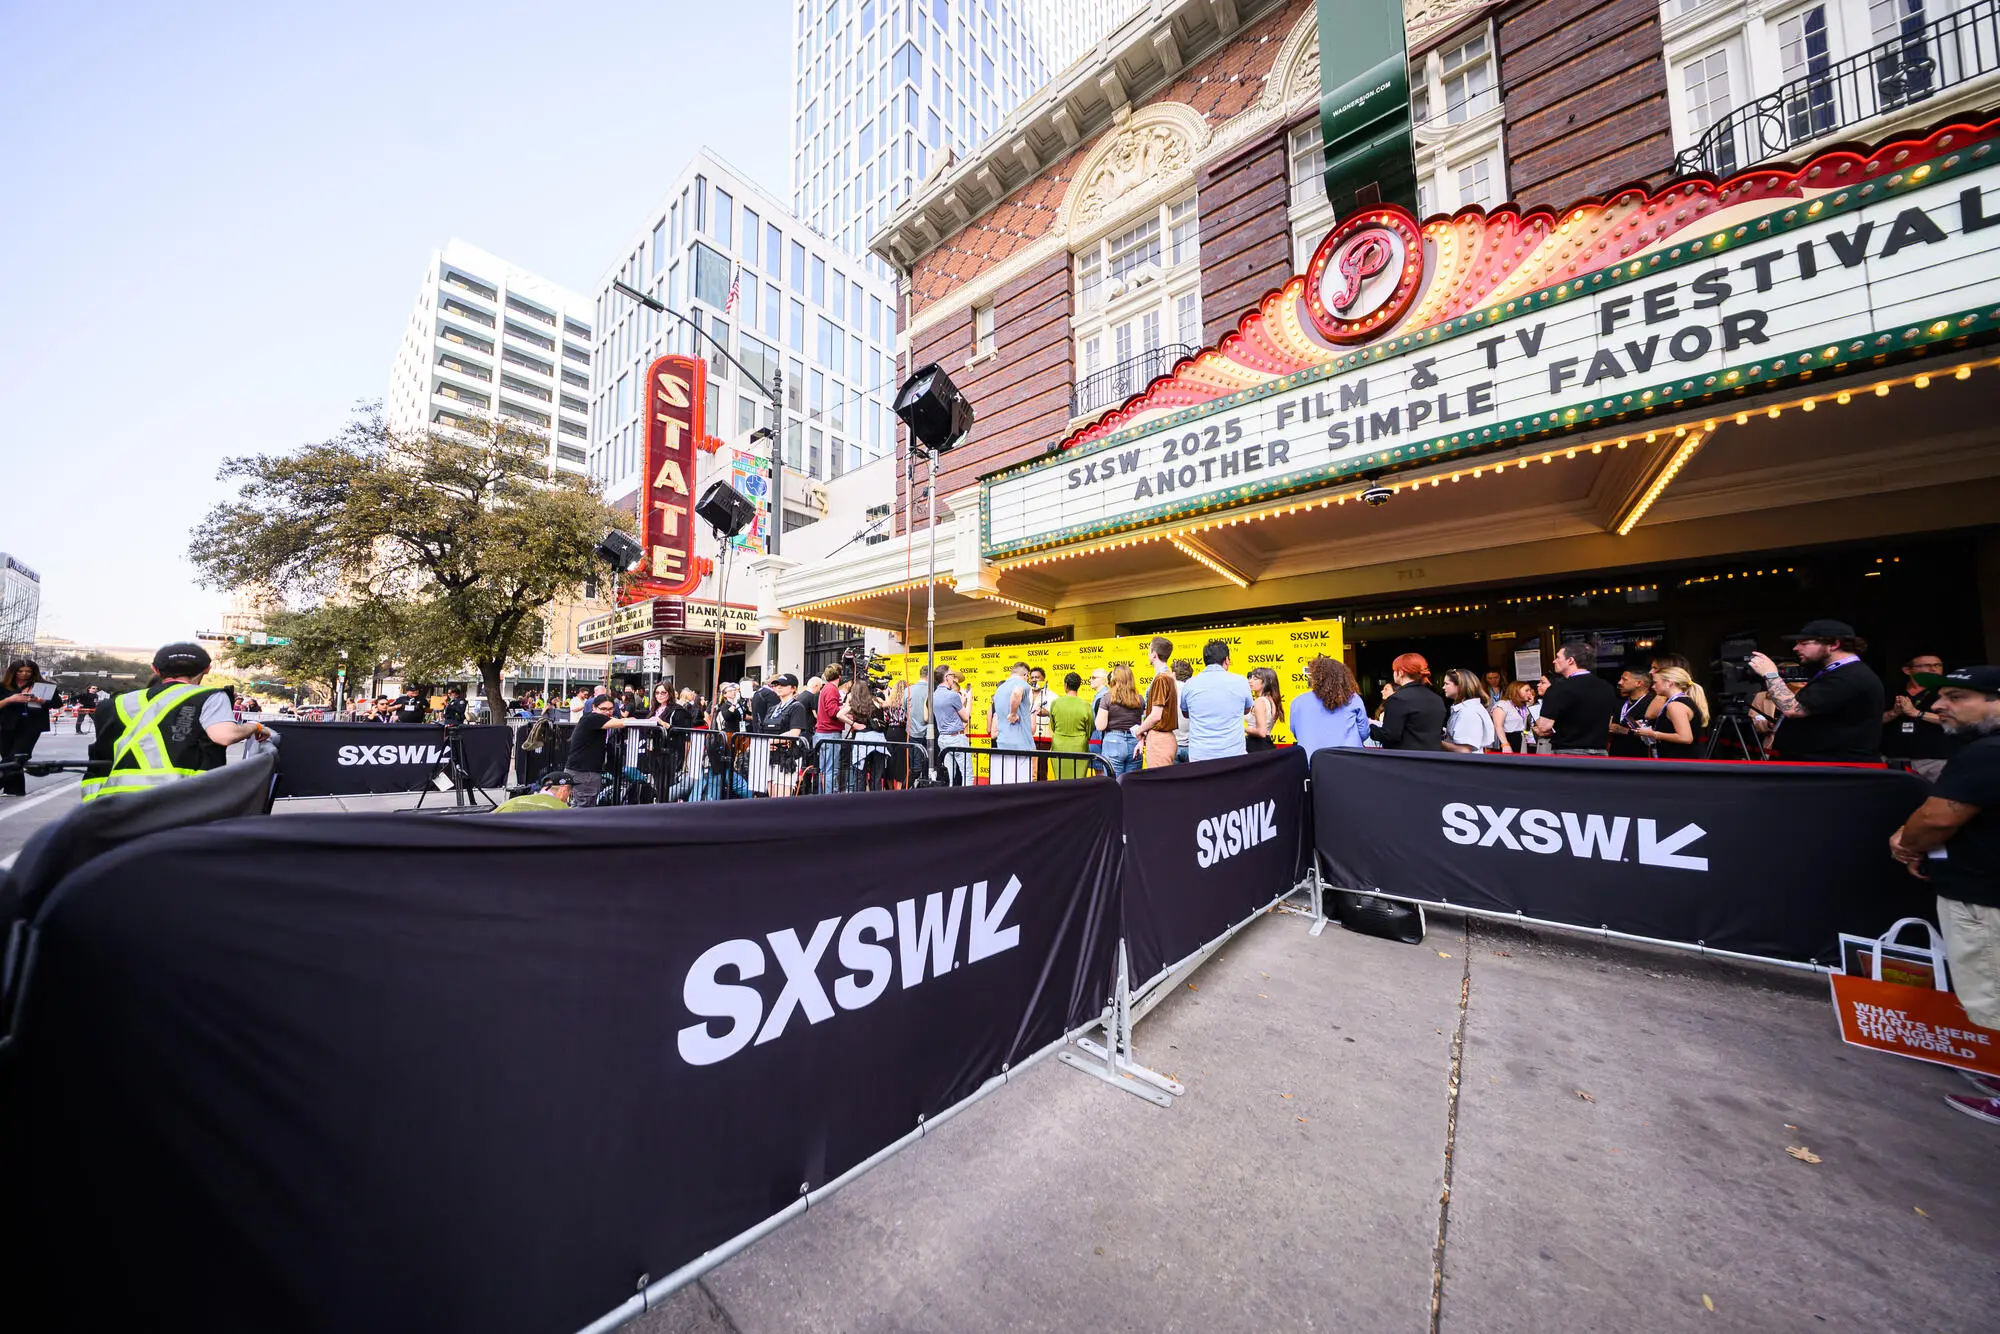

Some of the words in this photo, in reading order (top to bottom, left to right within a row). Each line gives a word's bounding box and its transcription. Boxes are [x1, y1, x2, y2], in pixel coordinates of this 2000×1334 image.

[1332, 81, 1391, 118] WAGNERSIGN.COM
[1068, 447, 1141, 490] SXSW
[1162, 416, 1243, 463] 2025
[1277, 378, 1370, 430] FILM
[1410, 357, 1438, 390] &
[1477, 321, 1546, 369] TV
[1601, 185, 2000, 337] FESTIVAL
[1134, 439, 1290, 501] ANOTHER
[1328, 380, 1495, 451] SIMPLE
[1549, 309, 1771, 395] FAVOR
[653, 373, 690, 582] STATE
[687, 604, 718, 617] HANK
[736, 622, 747, 631] 10
[1290, 631, 1319, 641] SXSW
[1027, 649, 1045, 657] SXSW
[1079, 646, 1098, 654] SXSW
[1248, 654, 1274, 663] SXSW
[1052, 663, 1070, 671] SXSW
[1292, 673, 1309, 682] SXS
[1140, 677, 1153, 685] SXS
[338, 745, 427, 766] SXSW
[1196, 802, 1260, 868] SXSW
[1441, 802, 1631, 862] SXSW
[676, 885, 968, 1067] SXSW
[1853, 1001, 1907, 1020] WHAT
[1856, 1010, 1928, 1032] STARTS
[1934, 1025, 1991, 1045] HERE
[1857, 1019, 1951, 1045] CHANGES
[1858, 1026, 1897, 1043] THE
[1902, 1035, 1976, 1059] WORLD
